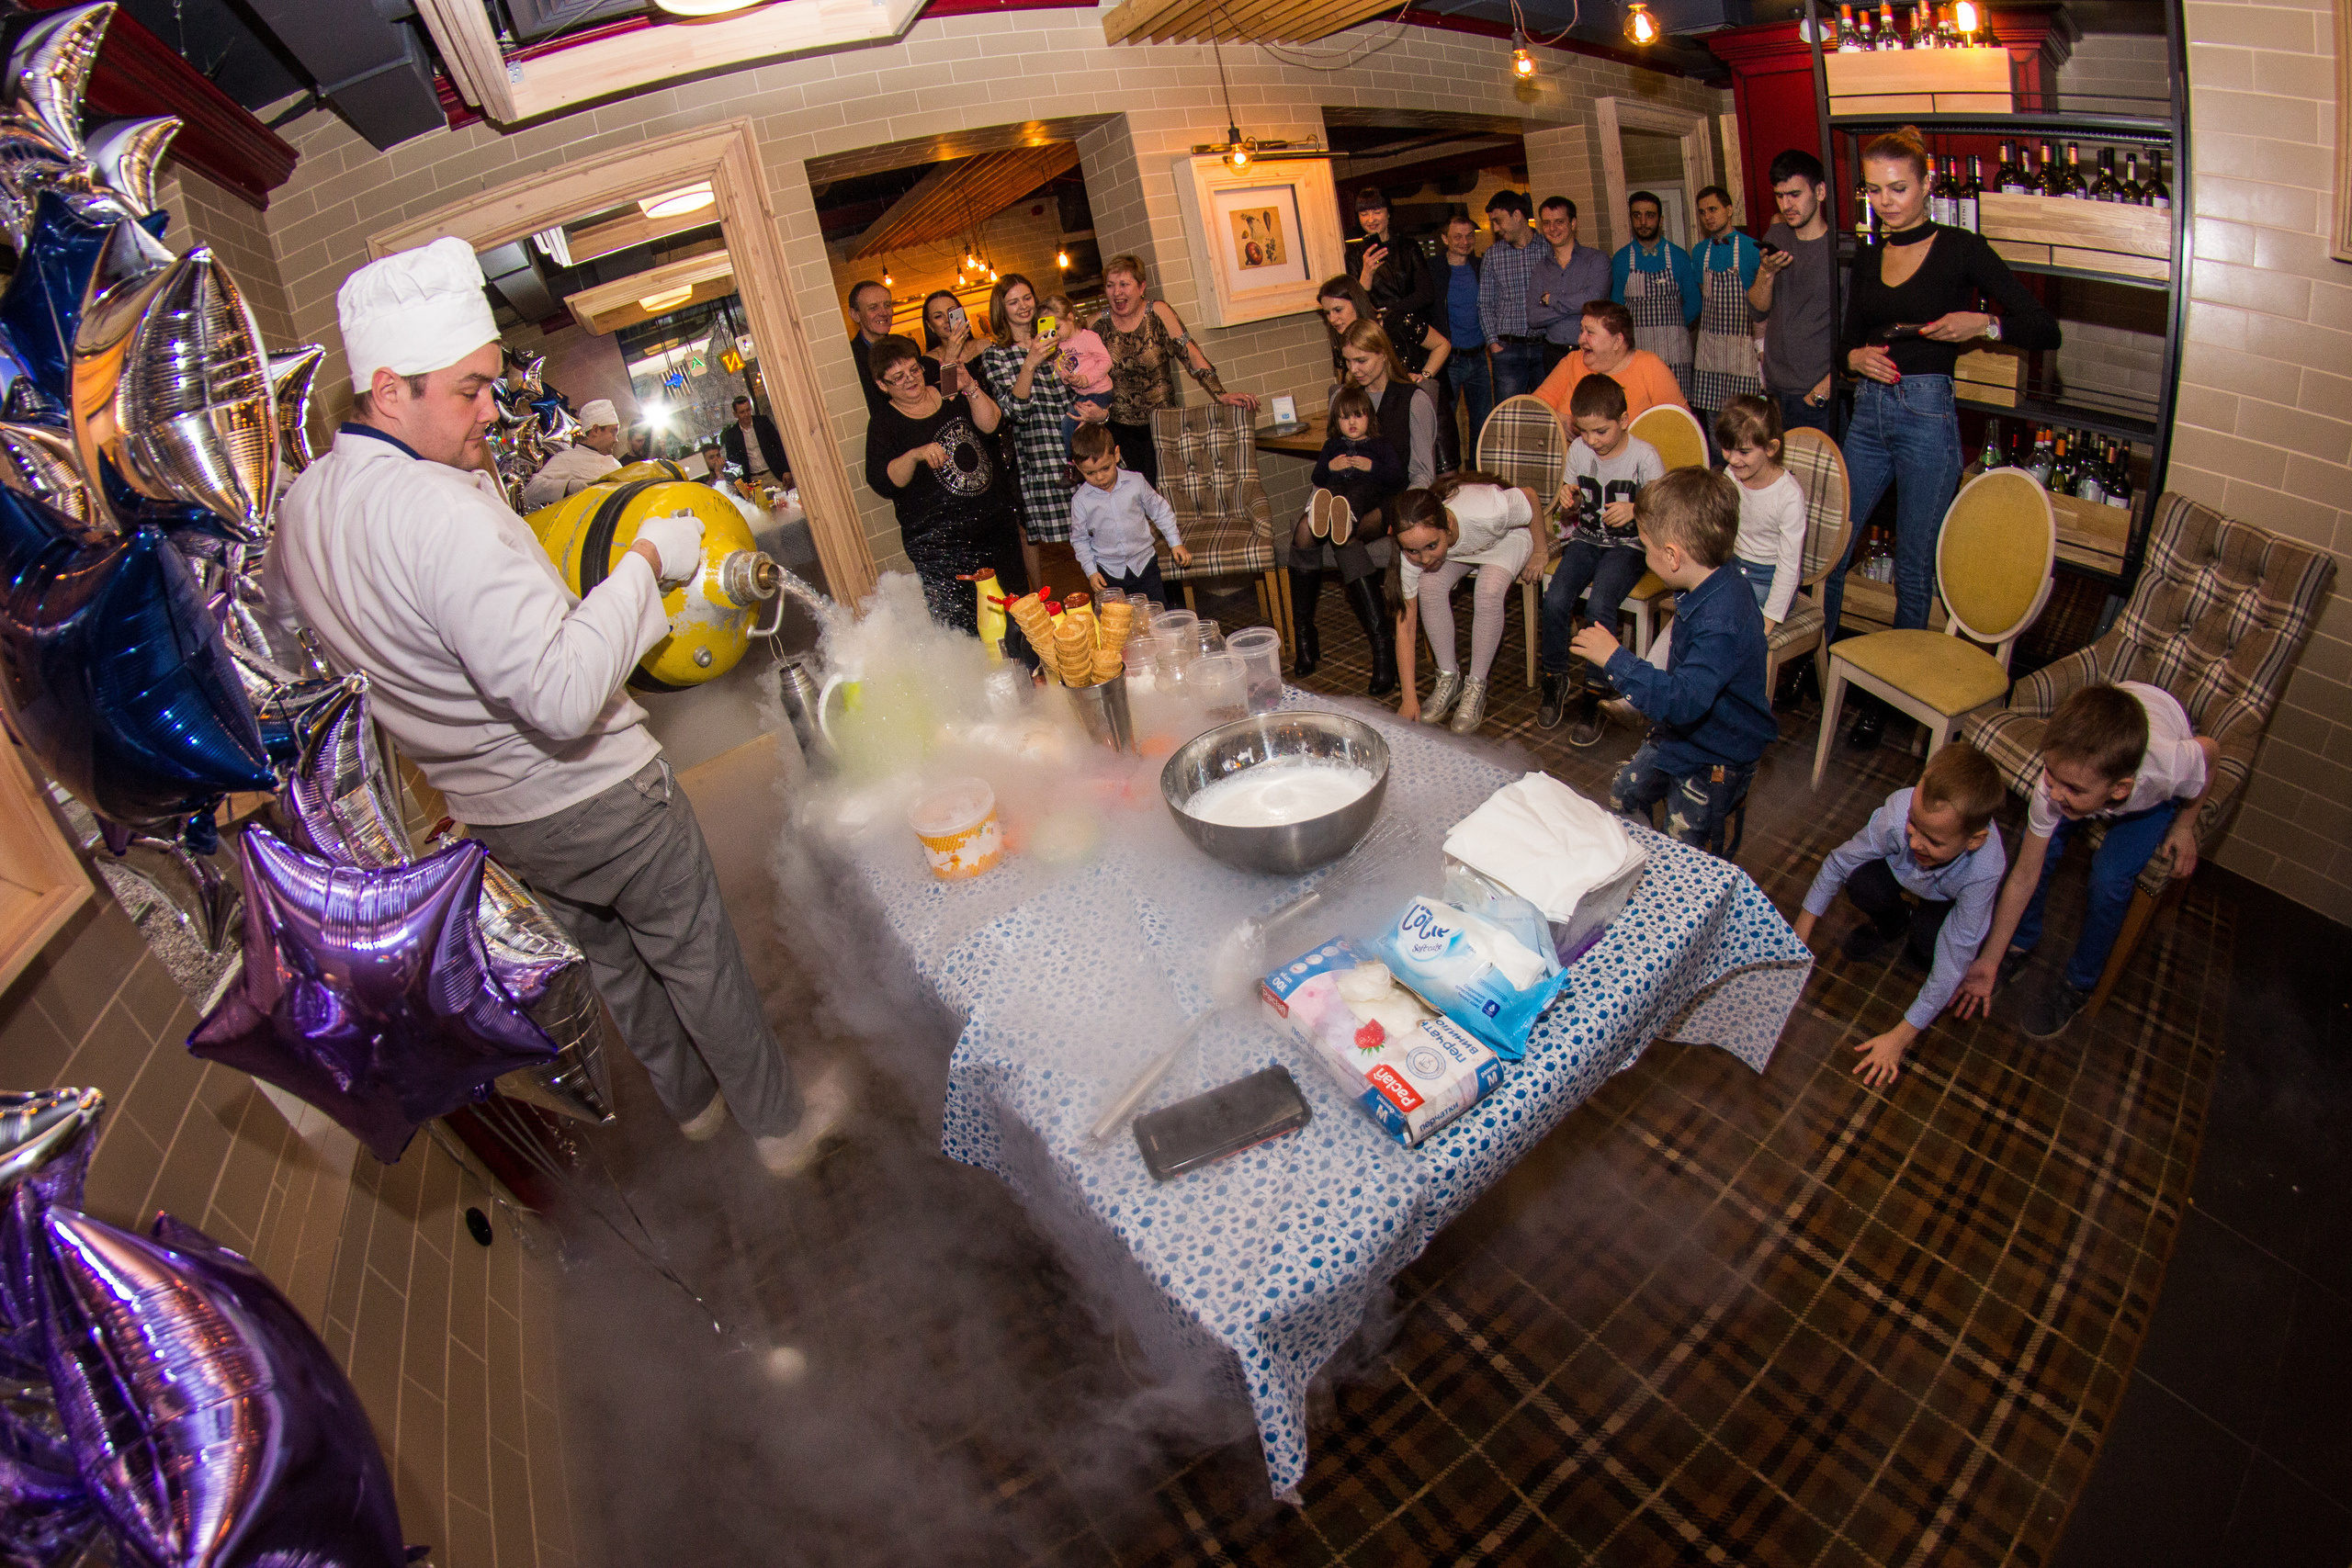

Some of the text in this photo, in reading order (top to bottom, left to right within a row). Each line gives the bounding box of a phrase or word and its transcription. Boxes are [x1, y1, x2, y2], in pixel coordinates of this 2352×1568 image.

[1272, 977, 1288, 992] 100
[1436, 1020, 1479, 1055] винило
[1374, 1067, 1416, 1106] Paclan
[1419, 1101, 1459, 1131] перчатки
